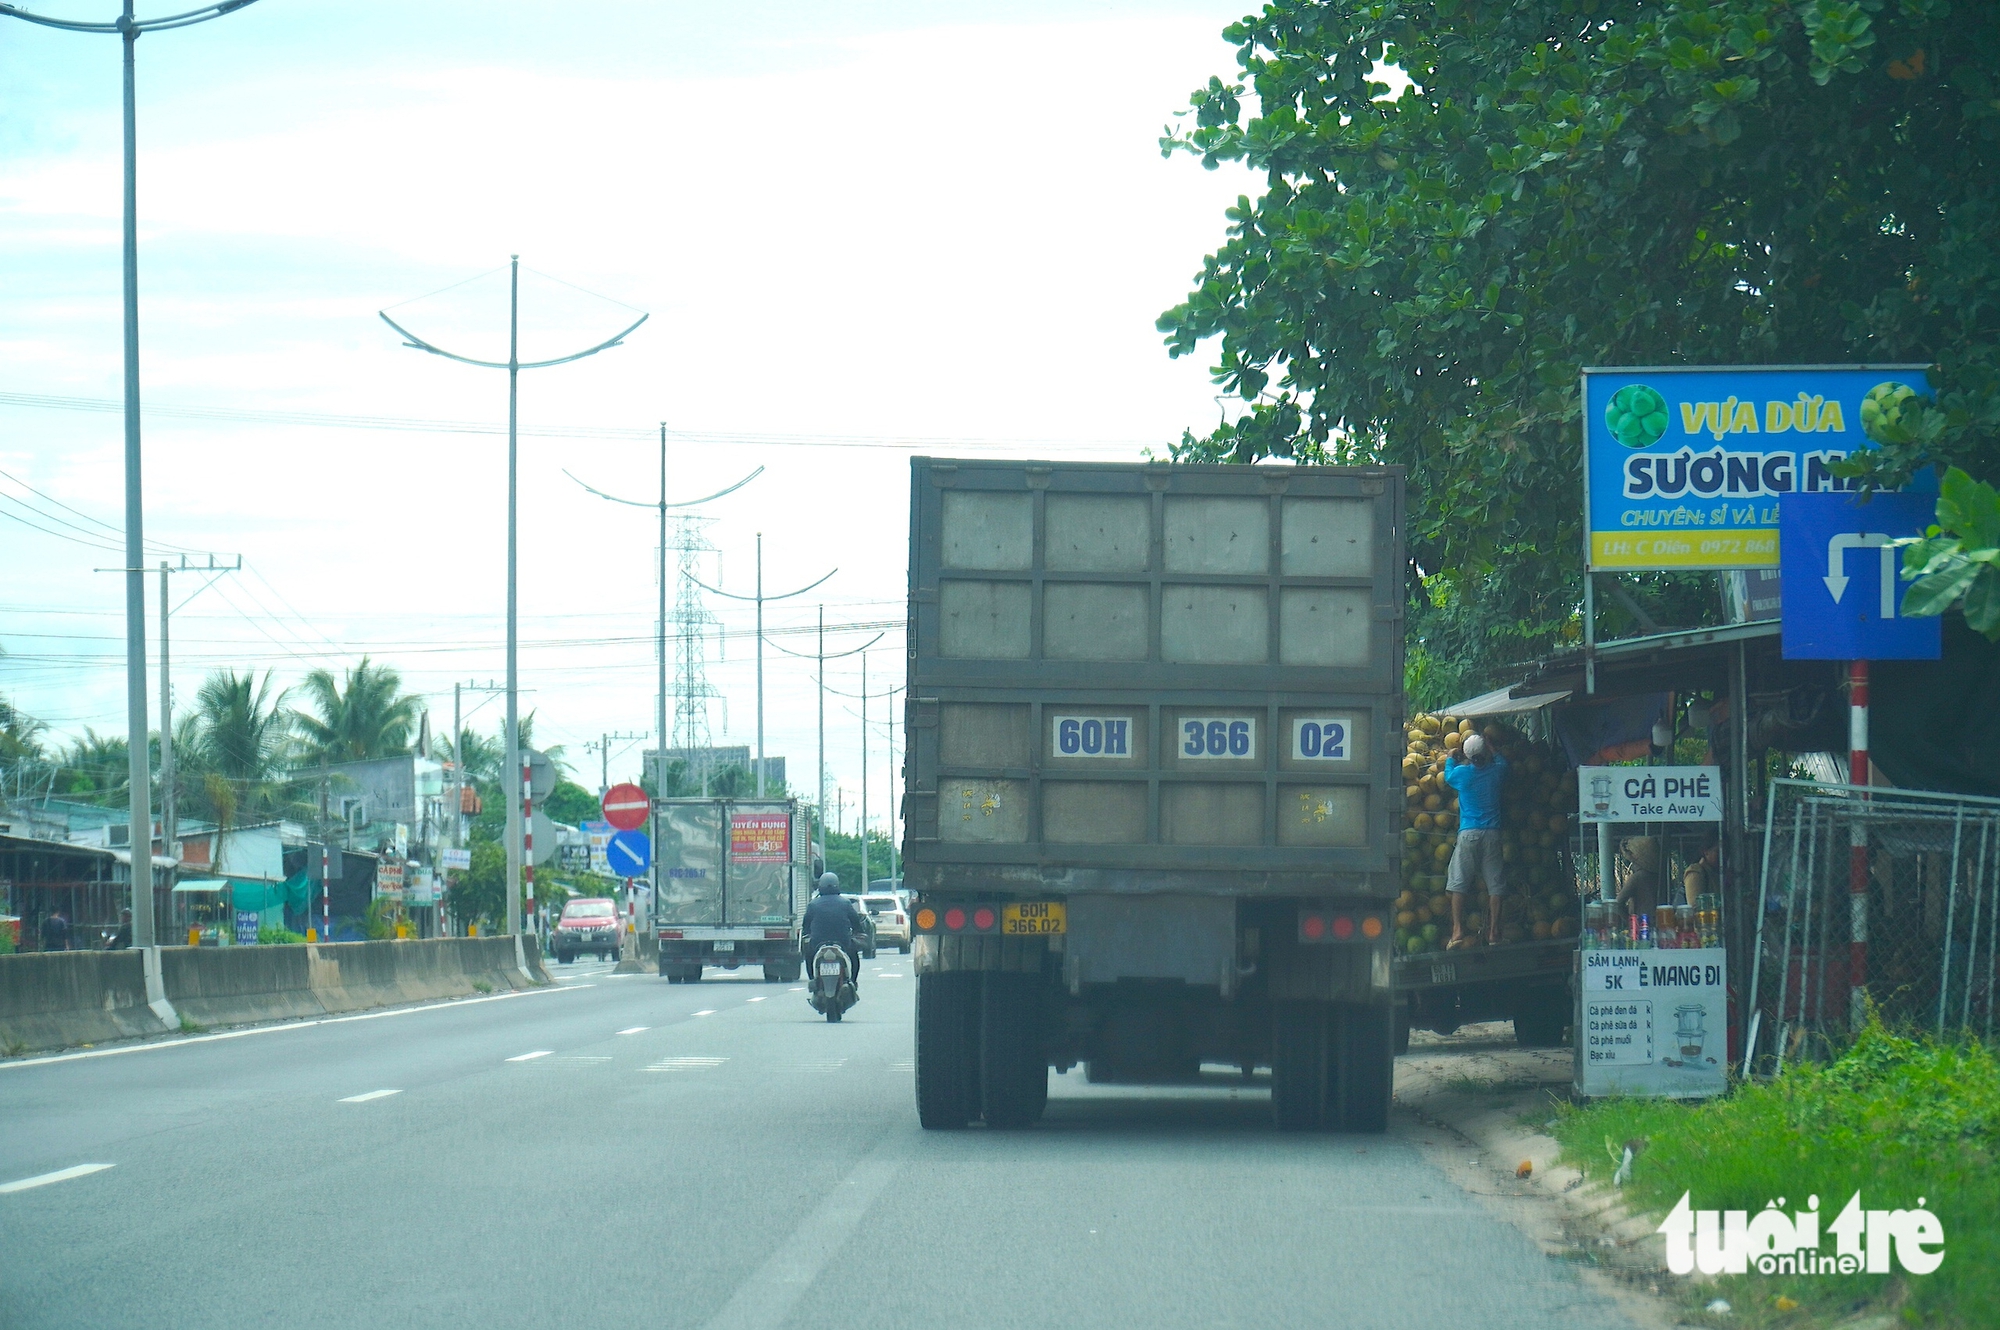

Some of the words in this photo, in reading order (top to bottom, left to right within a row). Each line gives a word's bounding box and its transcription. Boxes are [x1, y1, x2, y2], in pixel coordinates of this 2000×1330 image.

[1679, 395, 1760, 441] VỰA
[1765, 391, 1846, 433] DỪA
[1623, 446, 1796, 499] SƯƠNG
[1620, 504, 1706, 527] CHUYÊN:
[1731, 503, 1757, 525] VÀ
[1699, 539, 1741, 554] 0972
[1059, 718, 1127, 755] 60H
[1184, 720, 1250, 756] 366
[1300, 722, 1344, 758] 02
[1624, 773, 1656, 799] CÀ
[1664, 773, 1711, 798] PHÊ
[1631, 803, 1664, 815] Take
[1667, 803, 1705, 817] Away
[1020, 903, 1049, 918] 60H
[1008, 919, 1061, 933] 366.02
[1588, 952, 1610, 967] SÂM
[1612, 955, 1639, 970] LẠNH
[1604, 975, 1623, 990] 5K
[1653, 965, 1701, 987] MANG
[1705, 965, 1720, 986] ĐI
